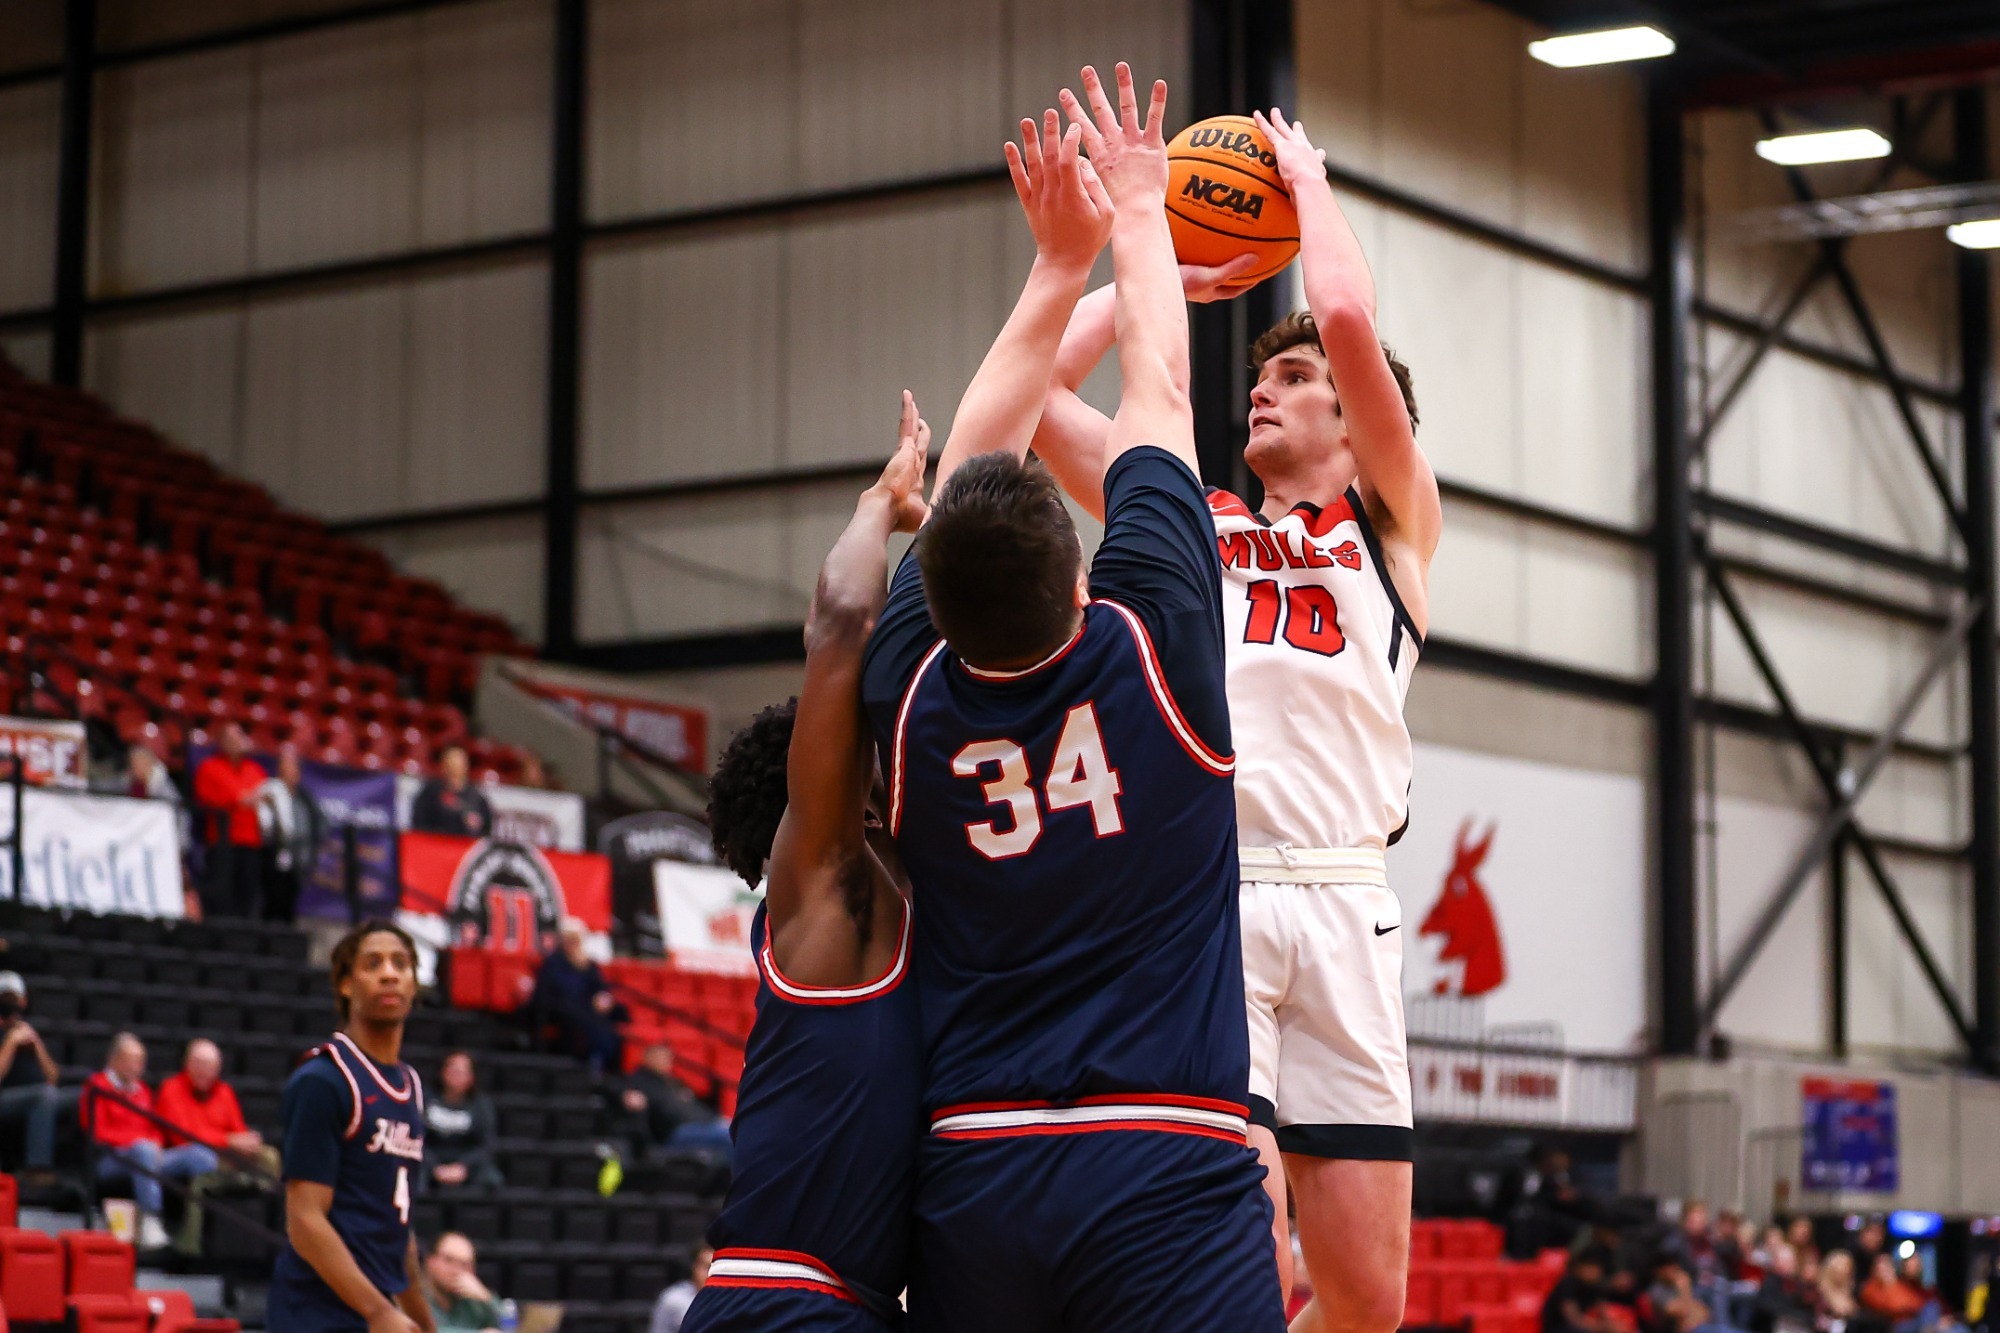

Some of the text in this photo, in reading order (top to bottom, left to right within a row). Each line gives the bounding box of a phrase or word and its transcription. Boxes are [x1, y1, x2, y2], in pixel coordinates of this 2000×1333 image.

[1189, 128, 1281, 176] Wilso
[1181, 173, 1265, 220] NCAA
[1218, 529, 1362, 571] MULES
[1243, 579, 1346, 658] 10
[950, 699, 1126, 861] 34
[393, 1165, 411, 1225] 4
